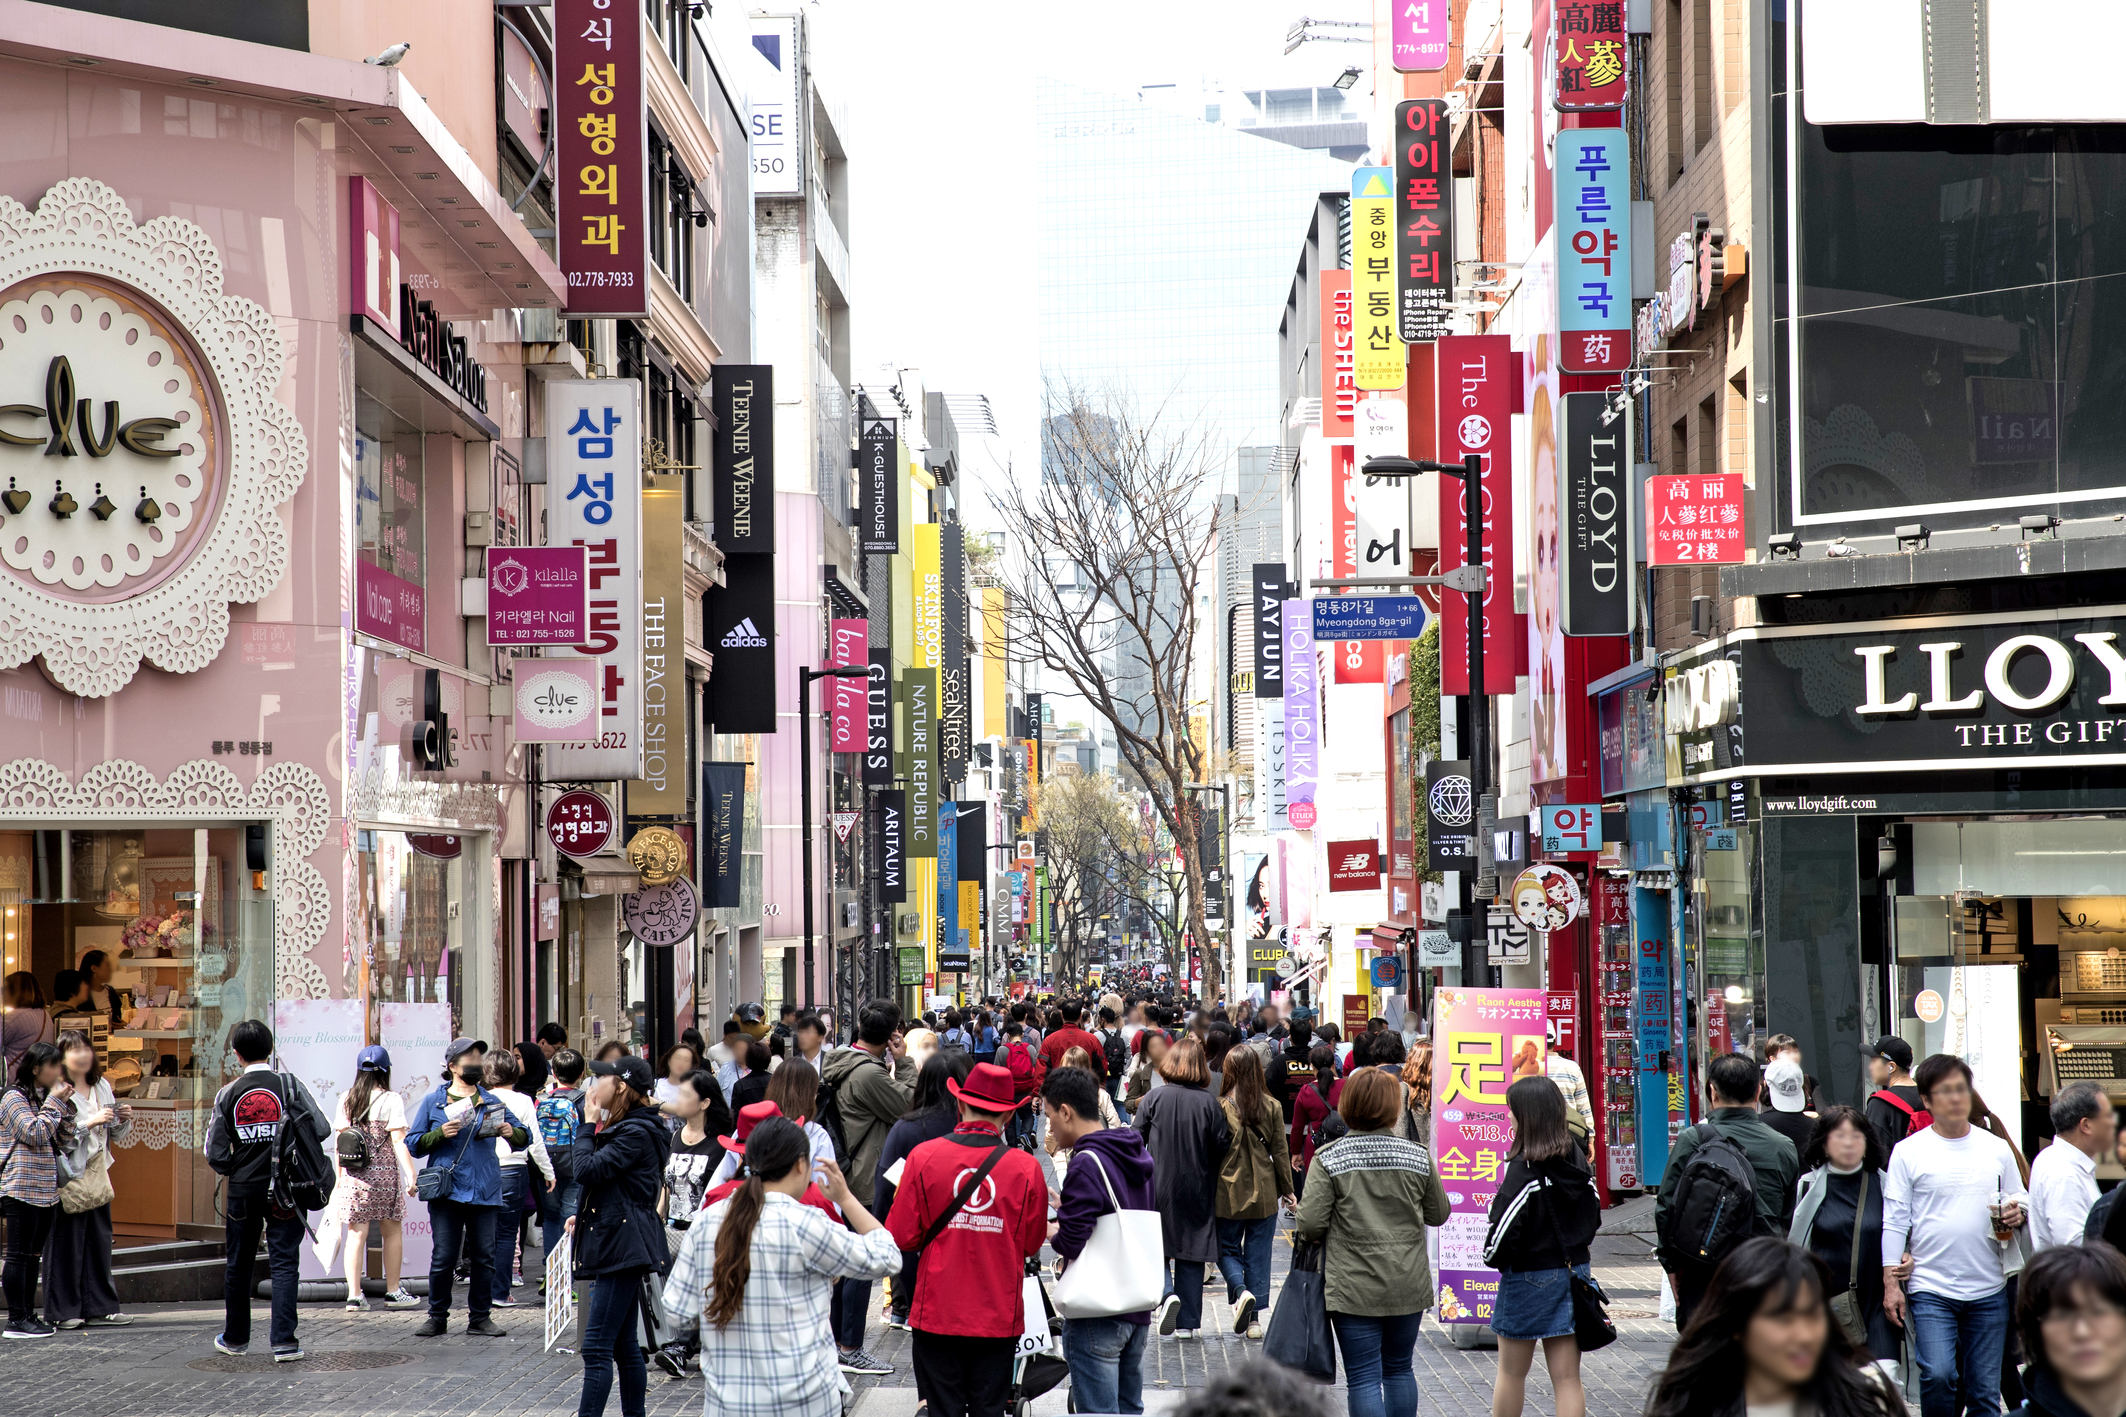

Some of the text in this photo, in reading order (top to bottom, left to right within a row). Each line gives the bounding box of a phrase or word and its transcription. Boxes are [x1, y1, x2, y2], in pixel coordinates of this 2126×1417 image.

[1404, 3, 1429, 33] 선
[1559, 3, 1622, 34] 高麗
[1396, 43, 1444, 54] 774-8917
[1561, 67, 1585, 93] 紅
[575, 63, 625, 254] 성형외과
[1406, 104, 1441, 283] 아이폰수리
[1572, 146, 1618, 318] 푸른약국
[569, 271, 634, 287] 02.778-7933
[1583, 334, 1612, 364] 药
[444, 321, 487, 414] Salon
[1462, 355, 1485, 407] The
[566, 407, 623, 525] 삼성
[732, 380, 755, 538] TEENIE WEENIE
[874, 443, 885, 539] K-GUESTHOUSE
[1667, 478, 1725, 500] 高丽
[1577, 476, 1586, 551] THE GIFT
[1590, 435, 1617, 593] LLOYD
[1676, 542, 1719, 560] 2楼
[534, 567, 578, 581] kilalla
[495, 610, 575, 624] 키라엘라 Nail
[1316, 600, 1374, 615] 명동8가길
[1408, 604, 1418, 612] 66
[924, 574, 940, 668] SKINFOOD
[1316, 616, 1412, 628] Myeongdong 8ga-gil
[495, 629, 575, 638] TEL 02) 755-1526
[721, 636, 768, 648] adidas
[1290, 614, 1310, 698] HOLIKA
[534, 685, 578, 708] clue
[644, 597, 667, 792] THE FACE SHOP
[868, 664, 887, 770] GUESS
[945, 669, 964, 759] seaNtree
[1029, 701, 1038, 727] AHC
[1955, 723, 2034, 748] THE
[211, 740, 273, 755] 클루 명동점
[912, 685, 929, 841] NATURE REPUBLIC
[561, 804, 592, 819] 노정식
[551, 820, 608, 843] 성형외과
[718, 791, 733, 877] TEENIE WEENIE
[1553, 808, 1593, 848] 약
[633, 833, 679, 872] THE FACE SHOP
[886, 806, 899, 887] ARITAUM
[1545, 836, 1559, 850] 药
[1334, 870, 1376, 879] new balance
[640, 925, 679, 942] CAFE
[1253, 949, 1283, 961] CLUB
[1641, 939, 1664, 963] 약
[1641, 966, 1665, 978] 药局
[1477, 994, 1542, 1008] Raon Aesthe
[1644, 993, 1663, 1012] 药
[1920, 1000, 1938, 1009] TAX
[1477, 1007, 1543, 1021] ラオンエステ
[274, 1031, 361, 1048] Spring Blossom
[384, 1035, 450, 1051] Spring Blossom
[1642, 1028, 1667, 1037] Ginseng
[1439, 1031, 1507, 1105] 足
[1644, 1053, 1657, 1063] 1F
[1442, 1110, 1464, 1121] 45分
[1439, 1146, 1503, 1182] 全身
[1621, 1175, 1634, 1186] 2F
[969, 1214, 1004, 1229] INFORMATION
